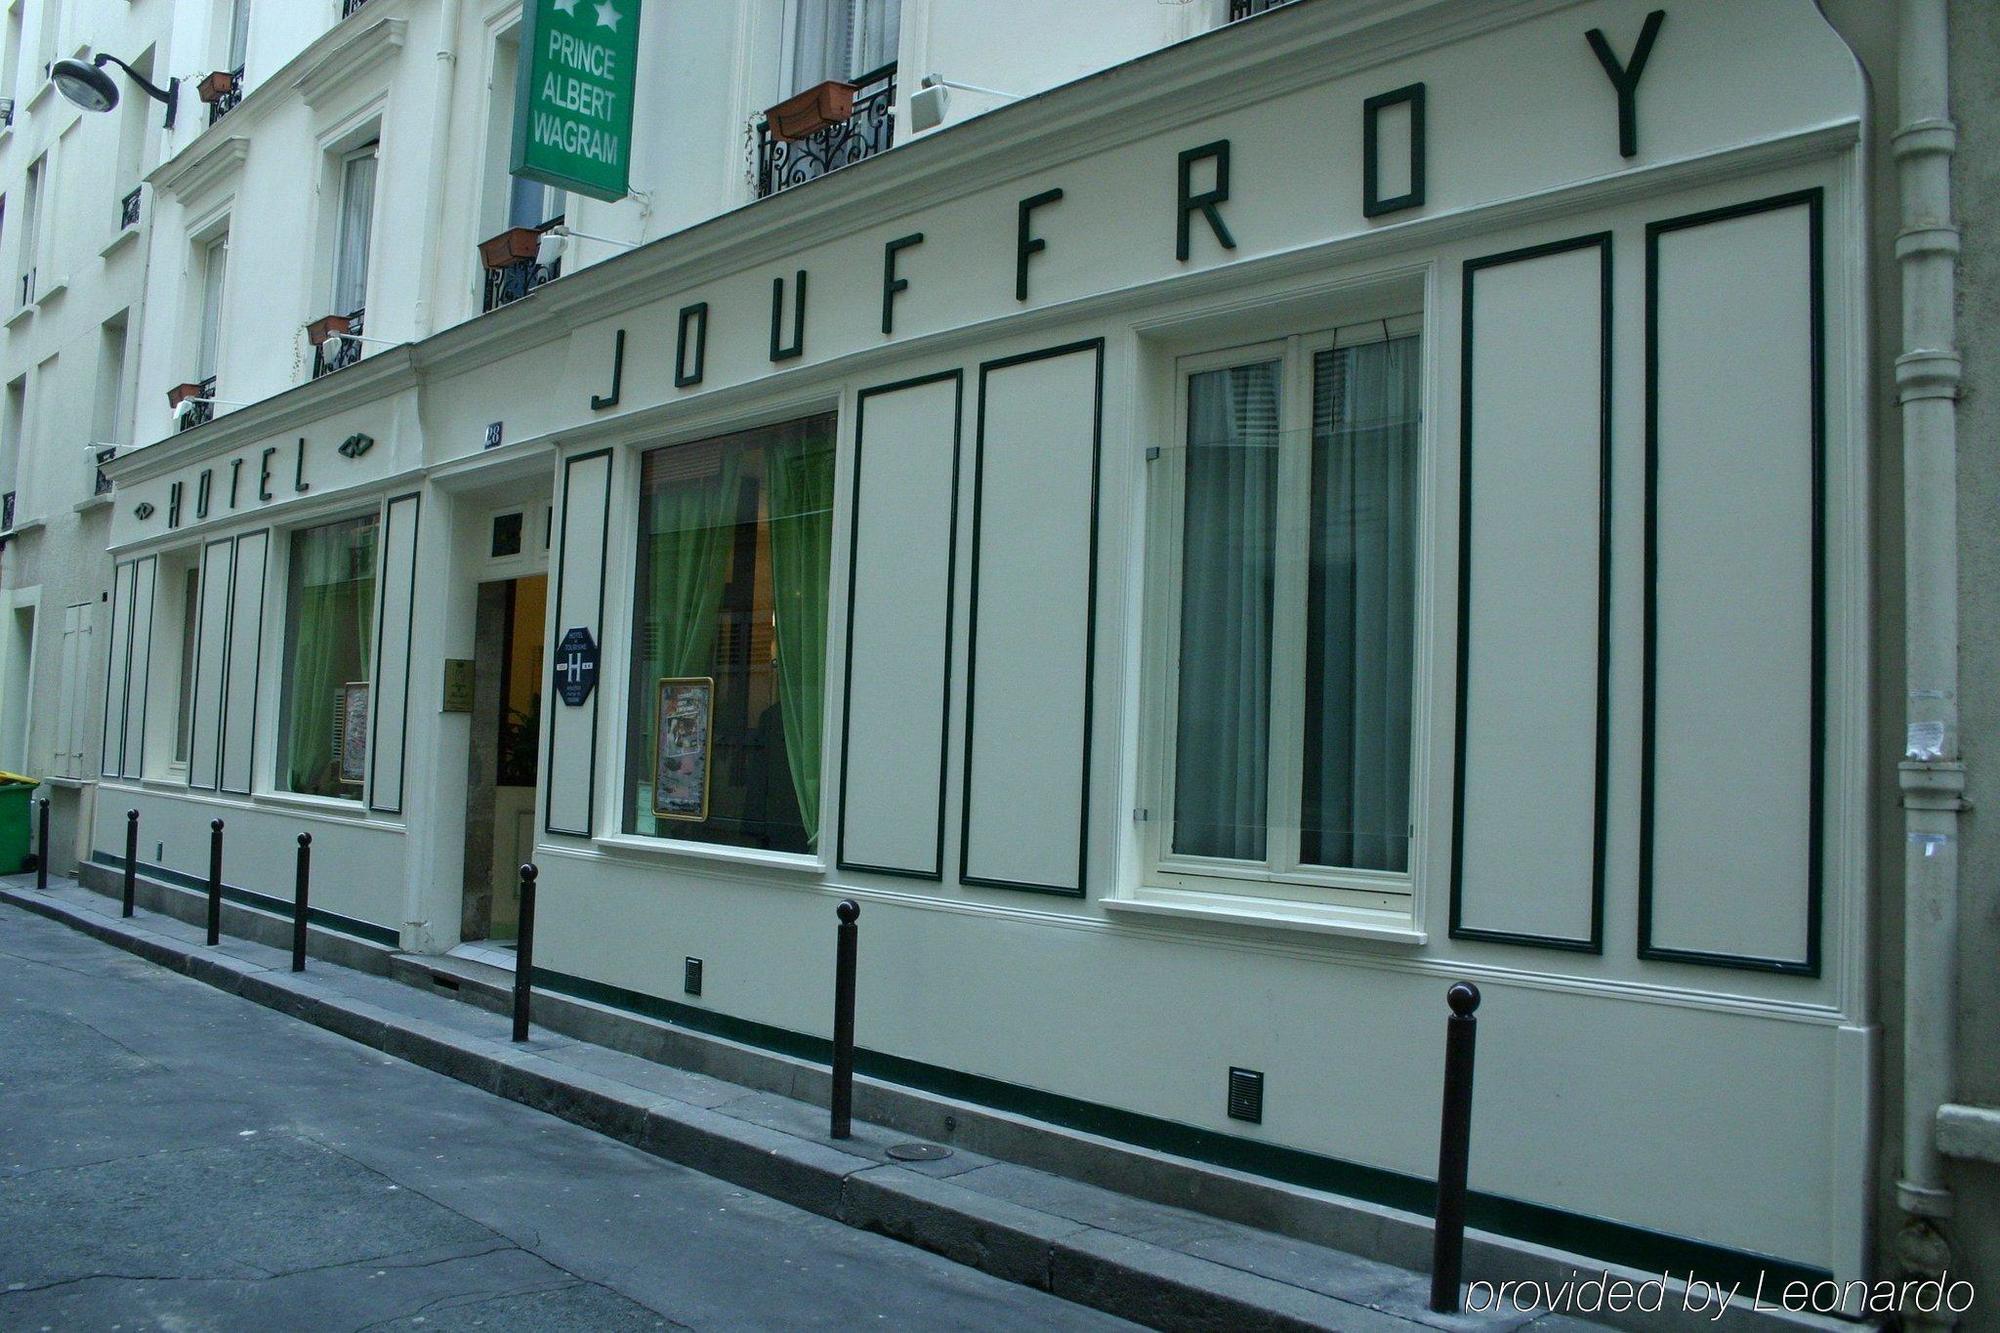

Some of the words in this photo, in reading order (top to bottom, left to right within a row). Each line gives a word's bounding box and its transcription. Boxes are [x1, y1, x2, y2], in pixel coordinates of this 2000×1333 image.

[549, 29, 617, 81] PRINCE
[541, 71, 616, 122] ALBERT
[534, 110, 619, 166] WAGRAM
[591, 9, 1667, 411] JOUFFROY
[485, 424, 500, 444] 28
[168, 437, 310, 529] HOTEL
[567, 652, 581, 682] H
